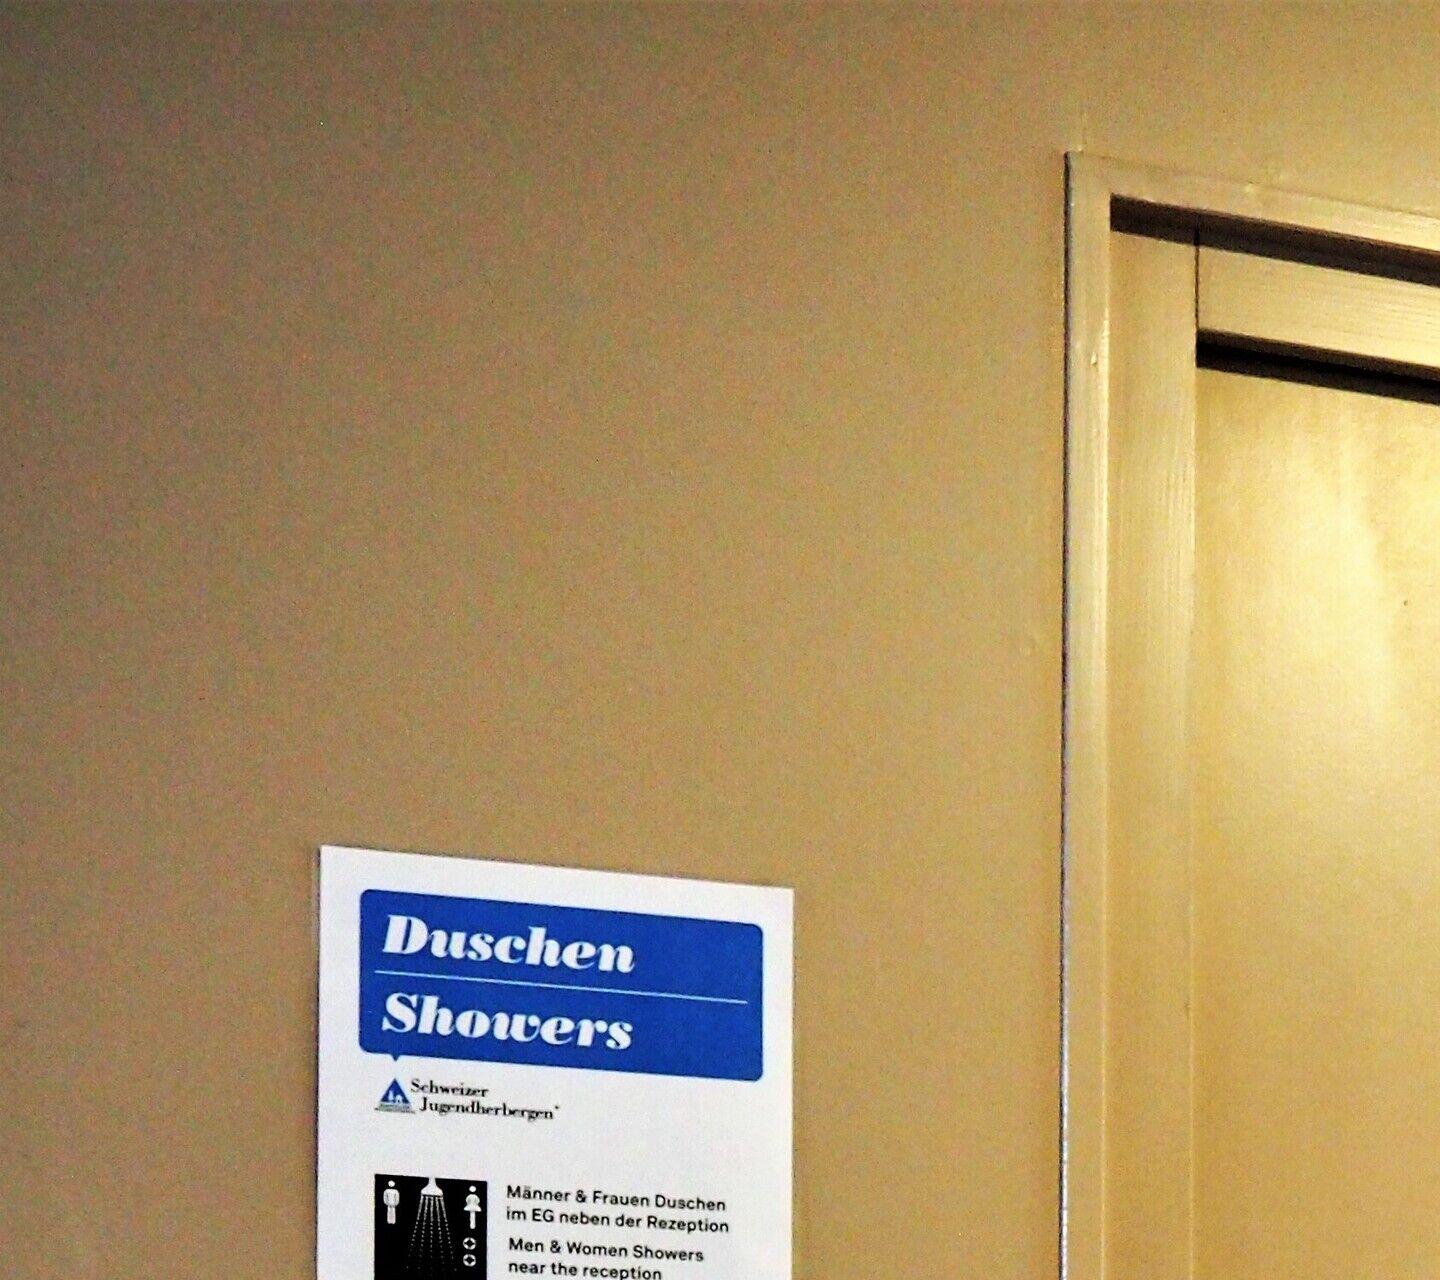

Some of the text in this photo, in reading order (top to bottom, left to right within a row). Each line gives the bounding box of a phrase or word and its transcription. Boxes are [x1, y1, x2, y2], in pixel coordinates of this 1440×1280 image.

[381, 914, 635, 974] Duschen
[381, 992, 633, 1050] Showers
[410, 1078, 489, 1097] Schweizer
[506, 1184, 726, 1211] Männer & Frauen Duschen
[506, 1207, 729, 1234] im EG neben der Rezeption
[508, 1238, 704, 1261] Men & Women Showers
[508, 1262, 546, 1275] near
[551, 1263, 577, 1276] the
